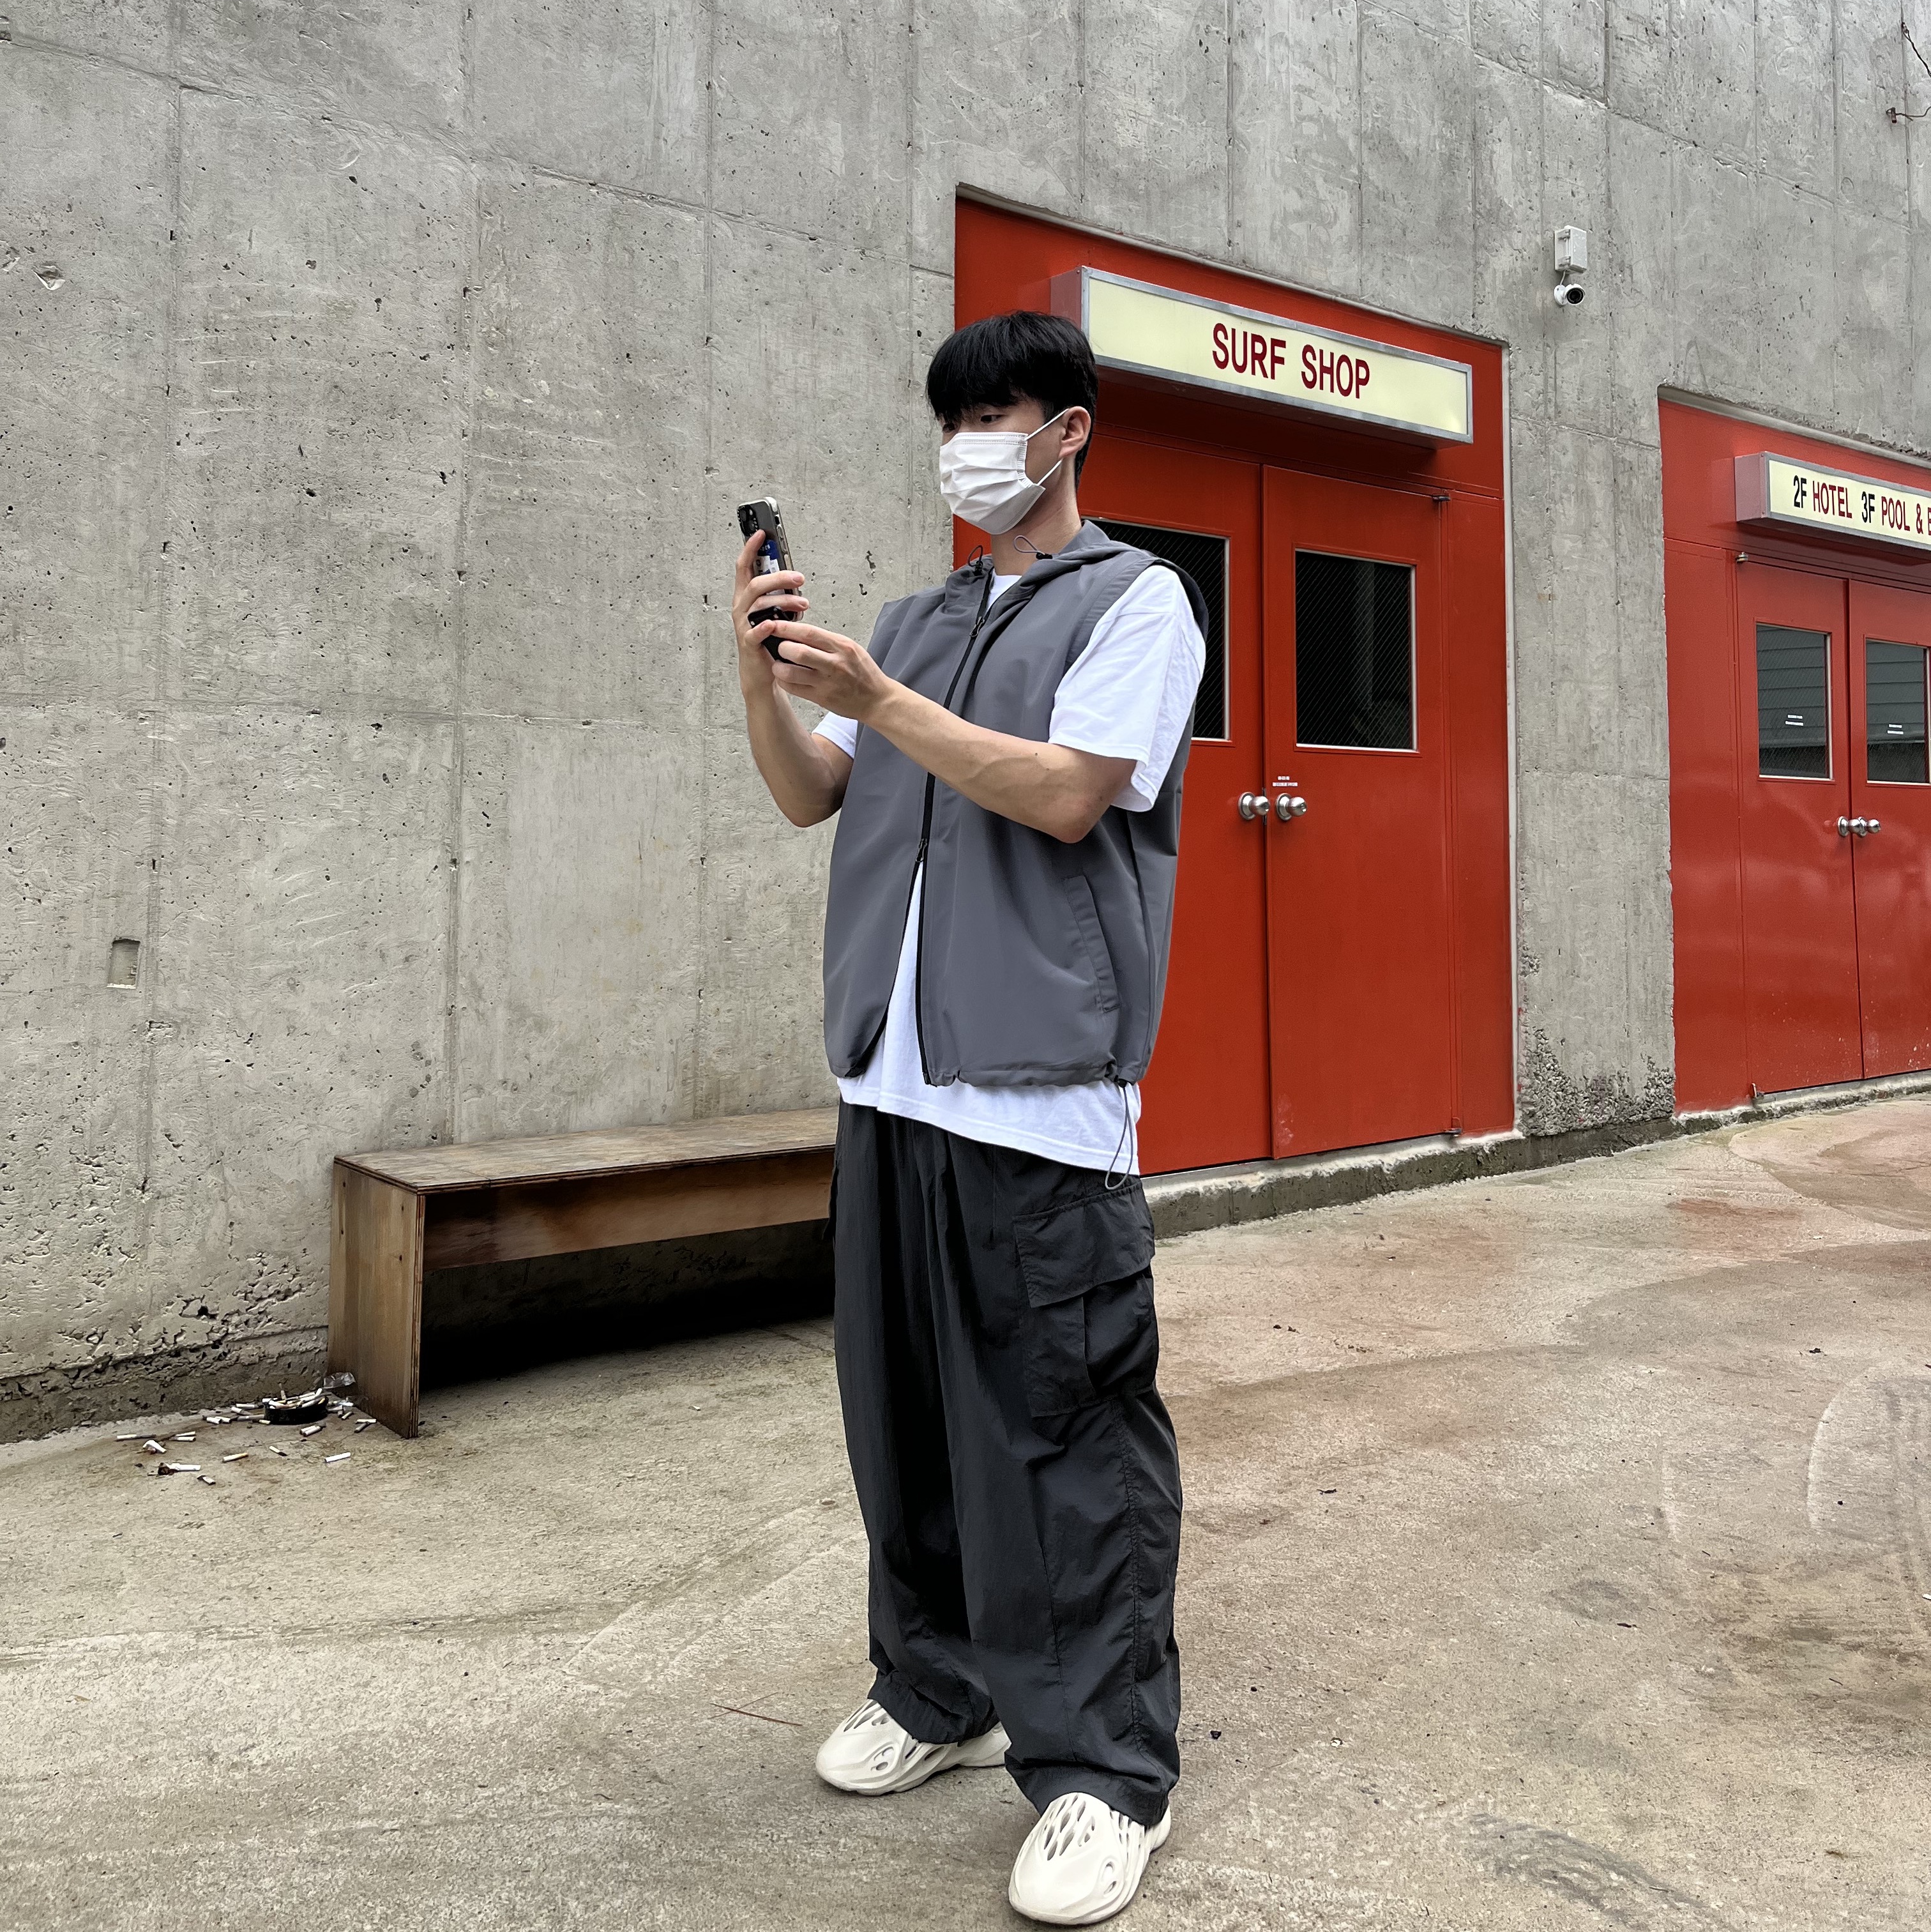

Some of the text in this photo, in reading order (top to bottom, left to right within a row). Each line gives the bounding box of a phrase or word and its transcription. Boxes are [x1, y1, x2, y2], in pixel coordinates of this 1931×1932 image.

[1212, 323, 1370, 399] SURF SHOP
[1793, 475, 1807, 508] 2F
[1812, 480, 1852, 519] HOTEL
[1861, 491, 1875, 524] 3F
[1881, 496, 1911, 531] POOL
[1916, 503, 1924, 535] &
